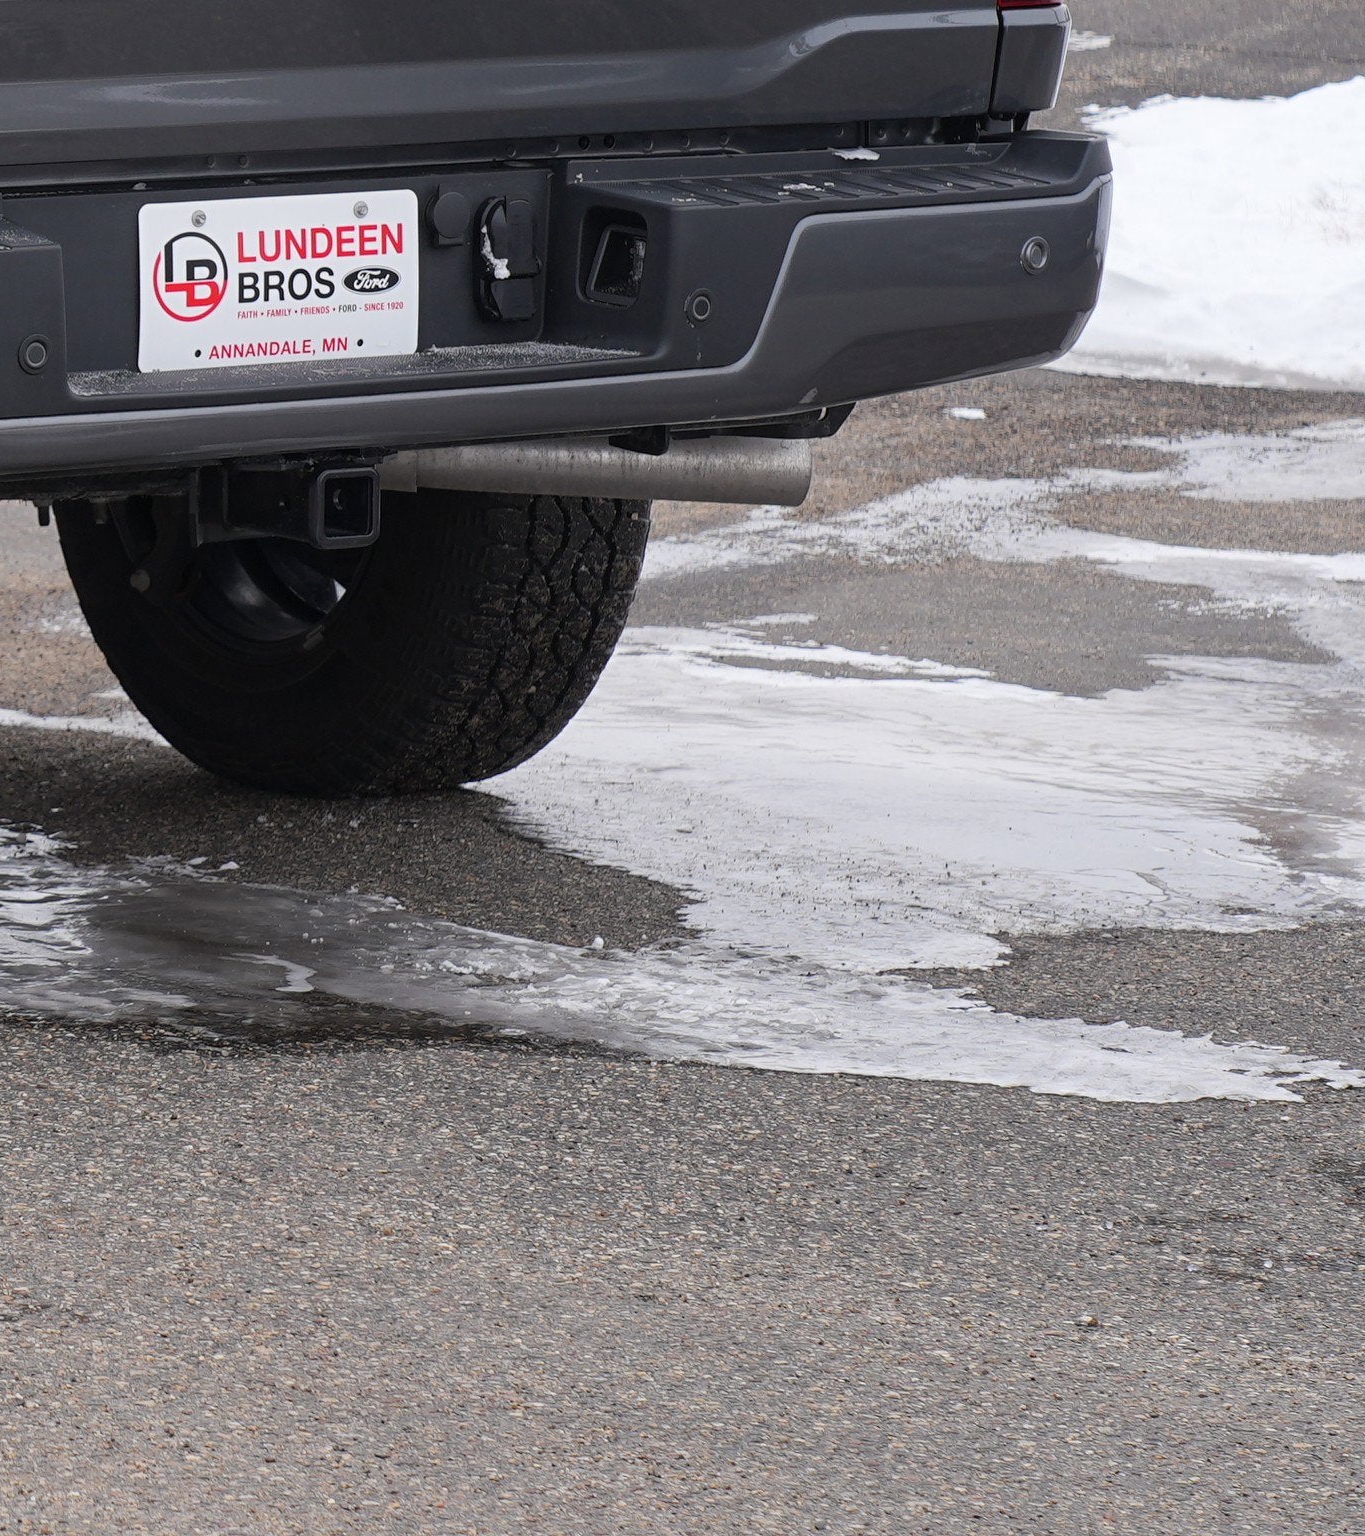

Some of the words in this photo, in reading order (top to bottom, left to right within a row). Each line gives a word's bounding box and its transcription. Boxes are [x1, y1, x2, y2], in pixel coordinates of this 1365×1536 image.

[237, 223, 403, 263] LUNDEEN
[238, 267, 335, 303] BROS
[237, 310, 258, 319] FAITH
[267, 309, 292, 317] FAMILY
[301, 306, 330, 315] FRIENDS
[339, 304, 357, 312] FORD
[364, 302, 385, 311] SINCE
[387, 301, 404, 310] 1920
[209, 340, 316, 360] ANNANDALE,
[322, 337, 348, 352] MN
